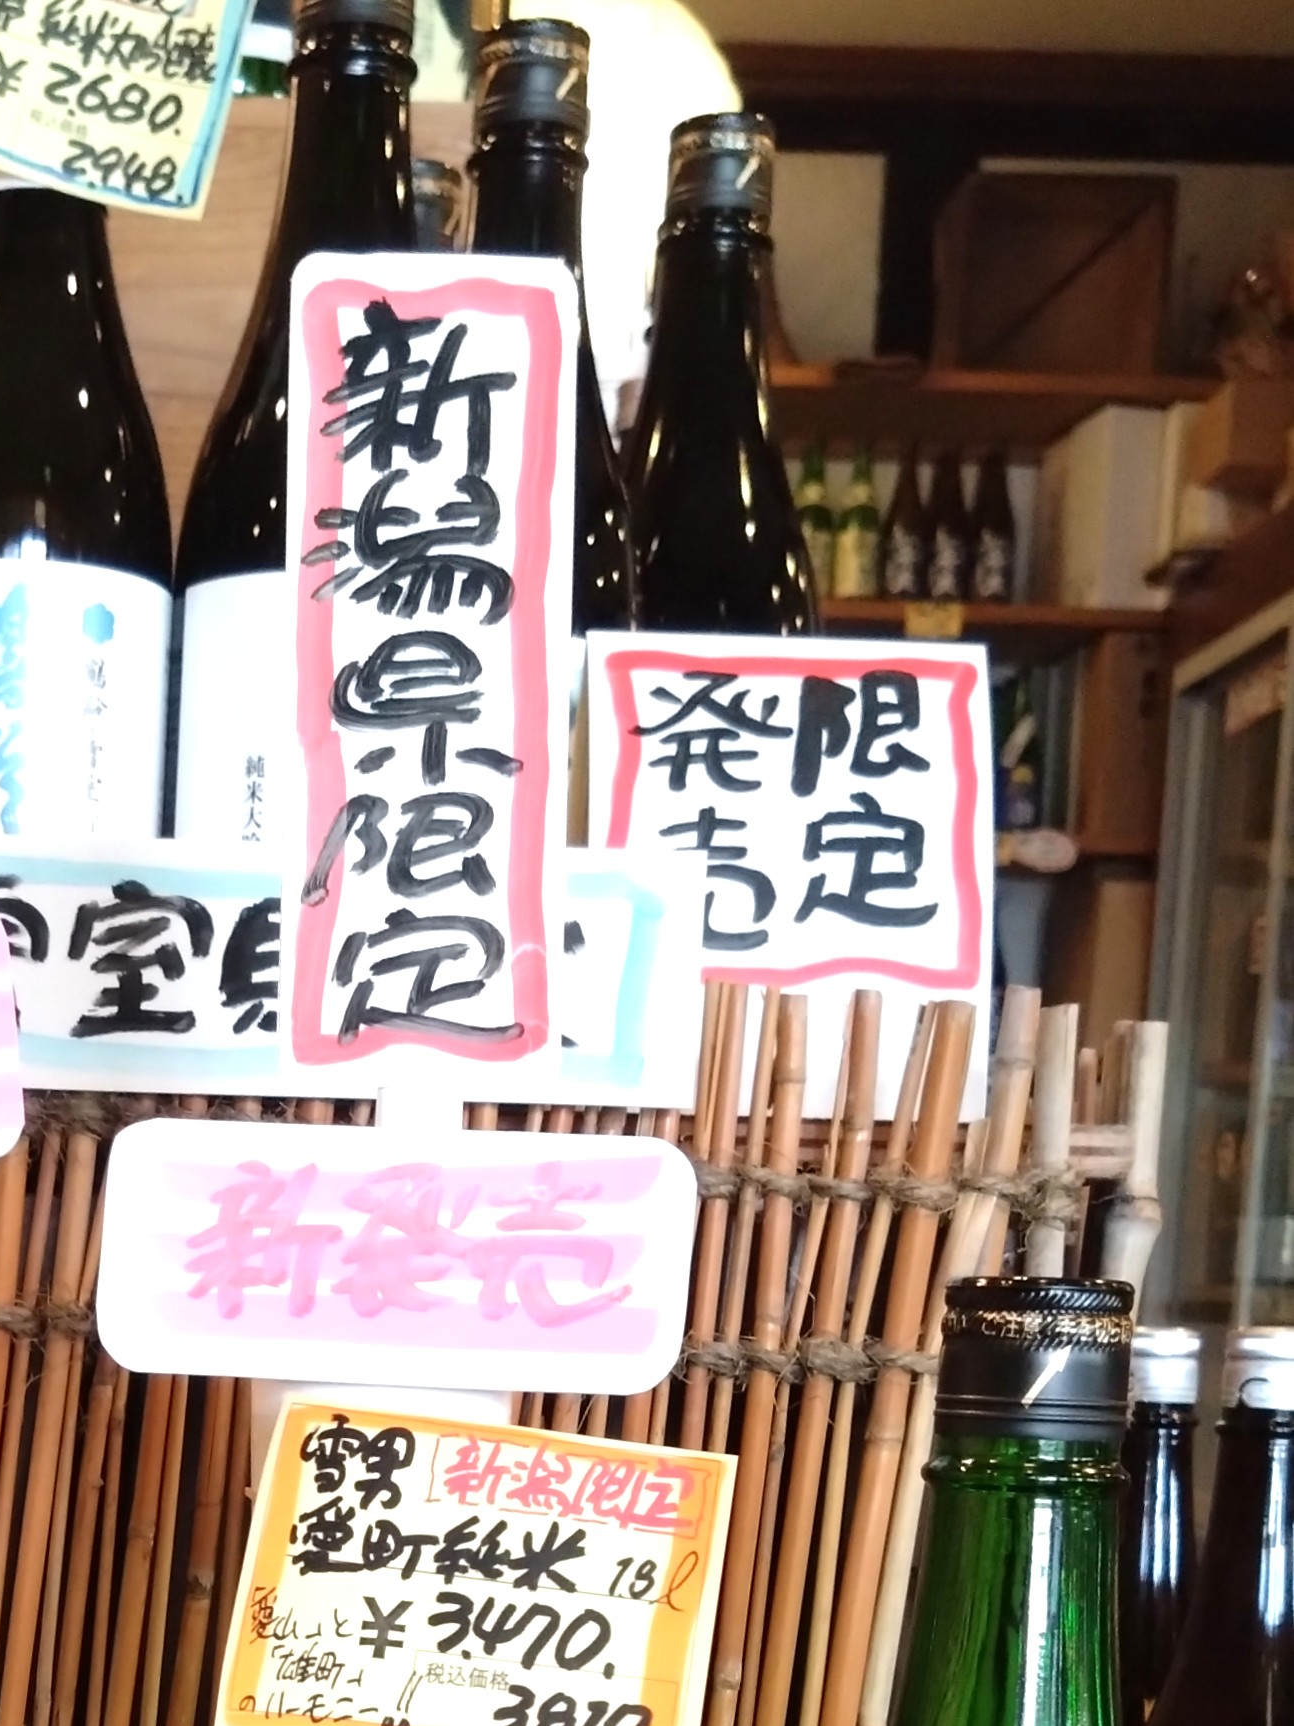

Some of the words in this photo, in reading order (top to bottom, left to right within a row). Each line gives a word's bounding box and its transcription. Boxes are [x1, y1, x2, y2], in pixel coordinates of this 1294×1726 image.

[302, 295, 525, 1044] 新潟県限定
[184, 1160, 632, 1327] 新発売
[300, 1414, 415, 1509] 雪男
[426, 1663, 510, 1690] 税込価格
